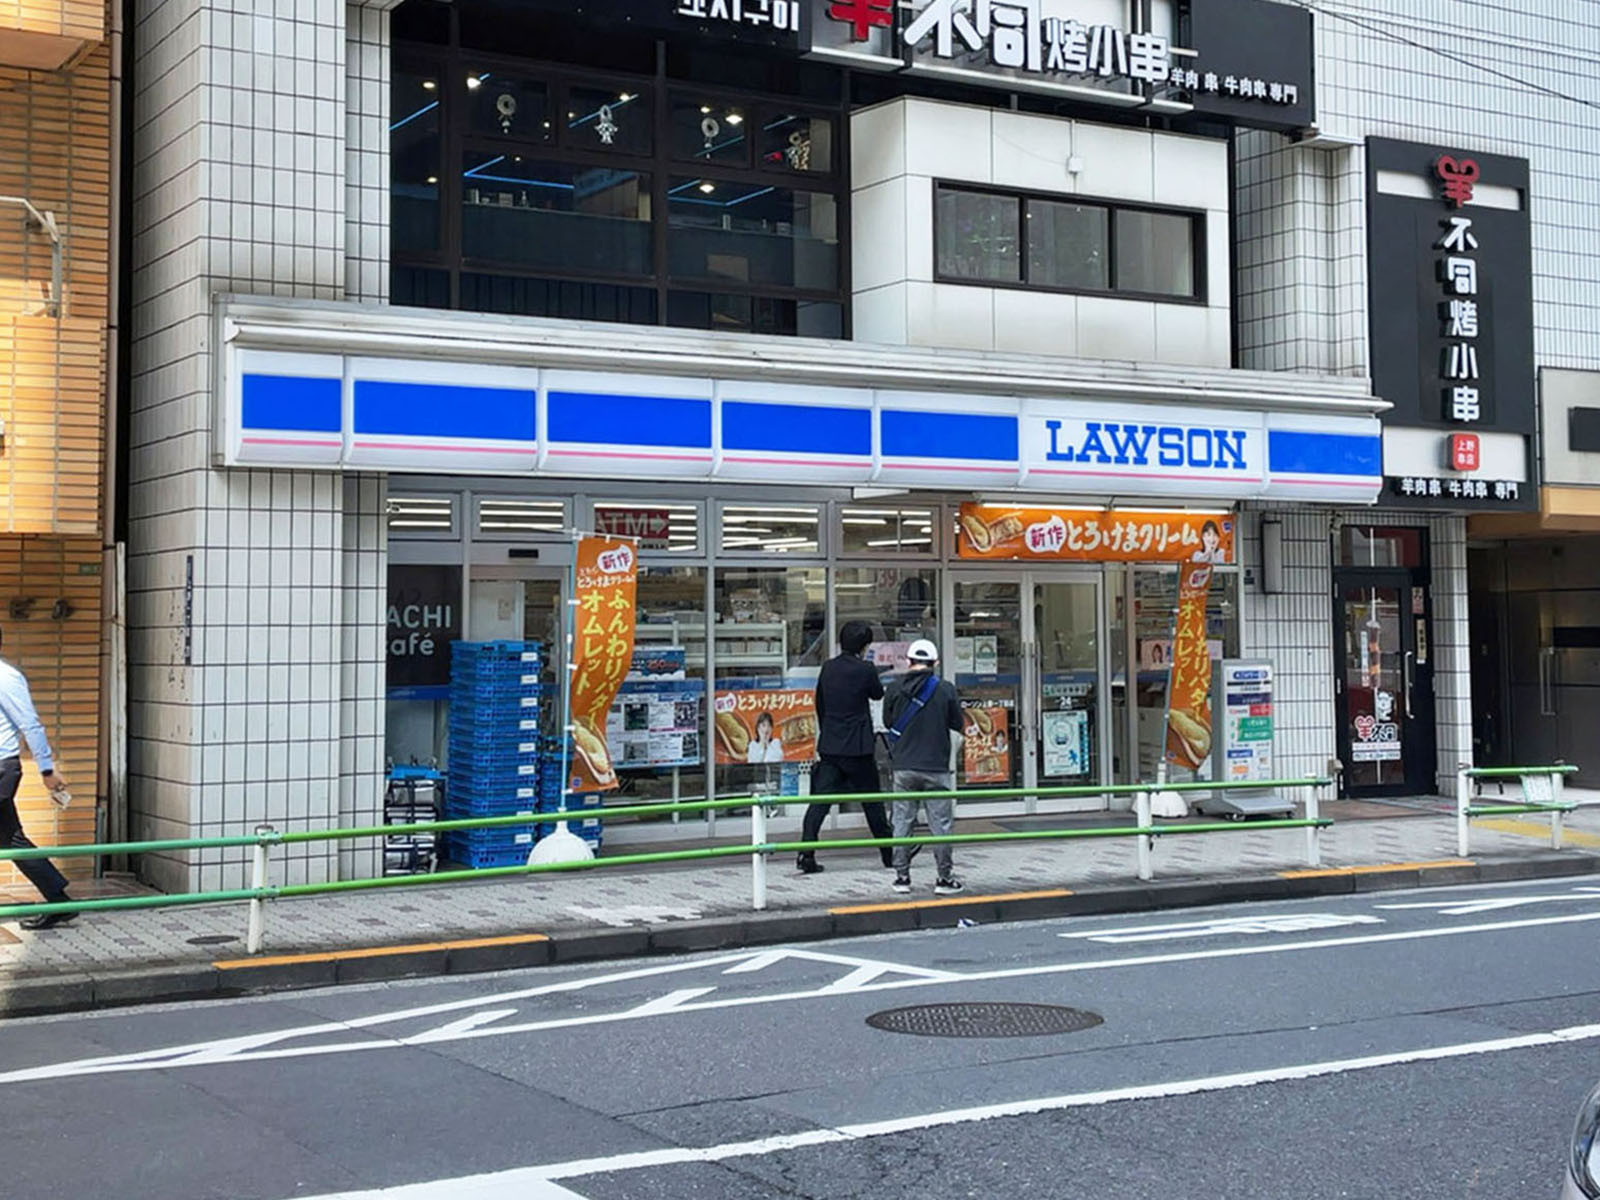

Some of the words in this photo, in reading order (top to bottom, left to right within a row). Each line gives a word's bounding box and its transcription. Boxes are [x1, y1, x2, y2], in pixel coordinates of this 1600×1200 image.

[1444, 217, 1480, 423] 不同烤小串
[1046, 420, 1247, 470] LAWSON
[595, 511, 648, 535] ATM
[1031, 526, 1063, 548] 新作
[602, 552, 630, 570] 新作
[386, 633, 435, 656] afé
[576, 589, 605, 695] オムレット
[1175, 600, 1195, 689] オムレット
